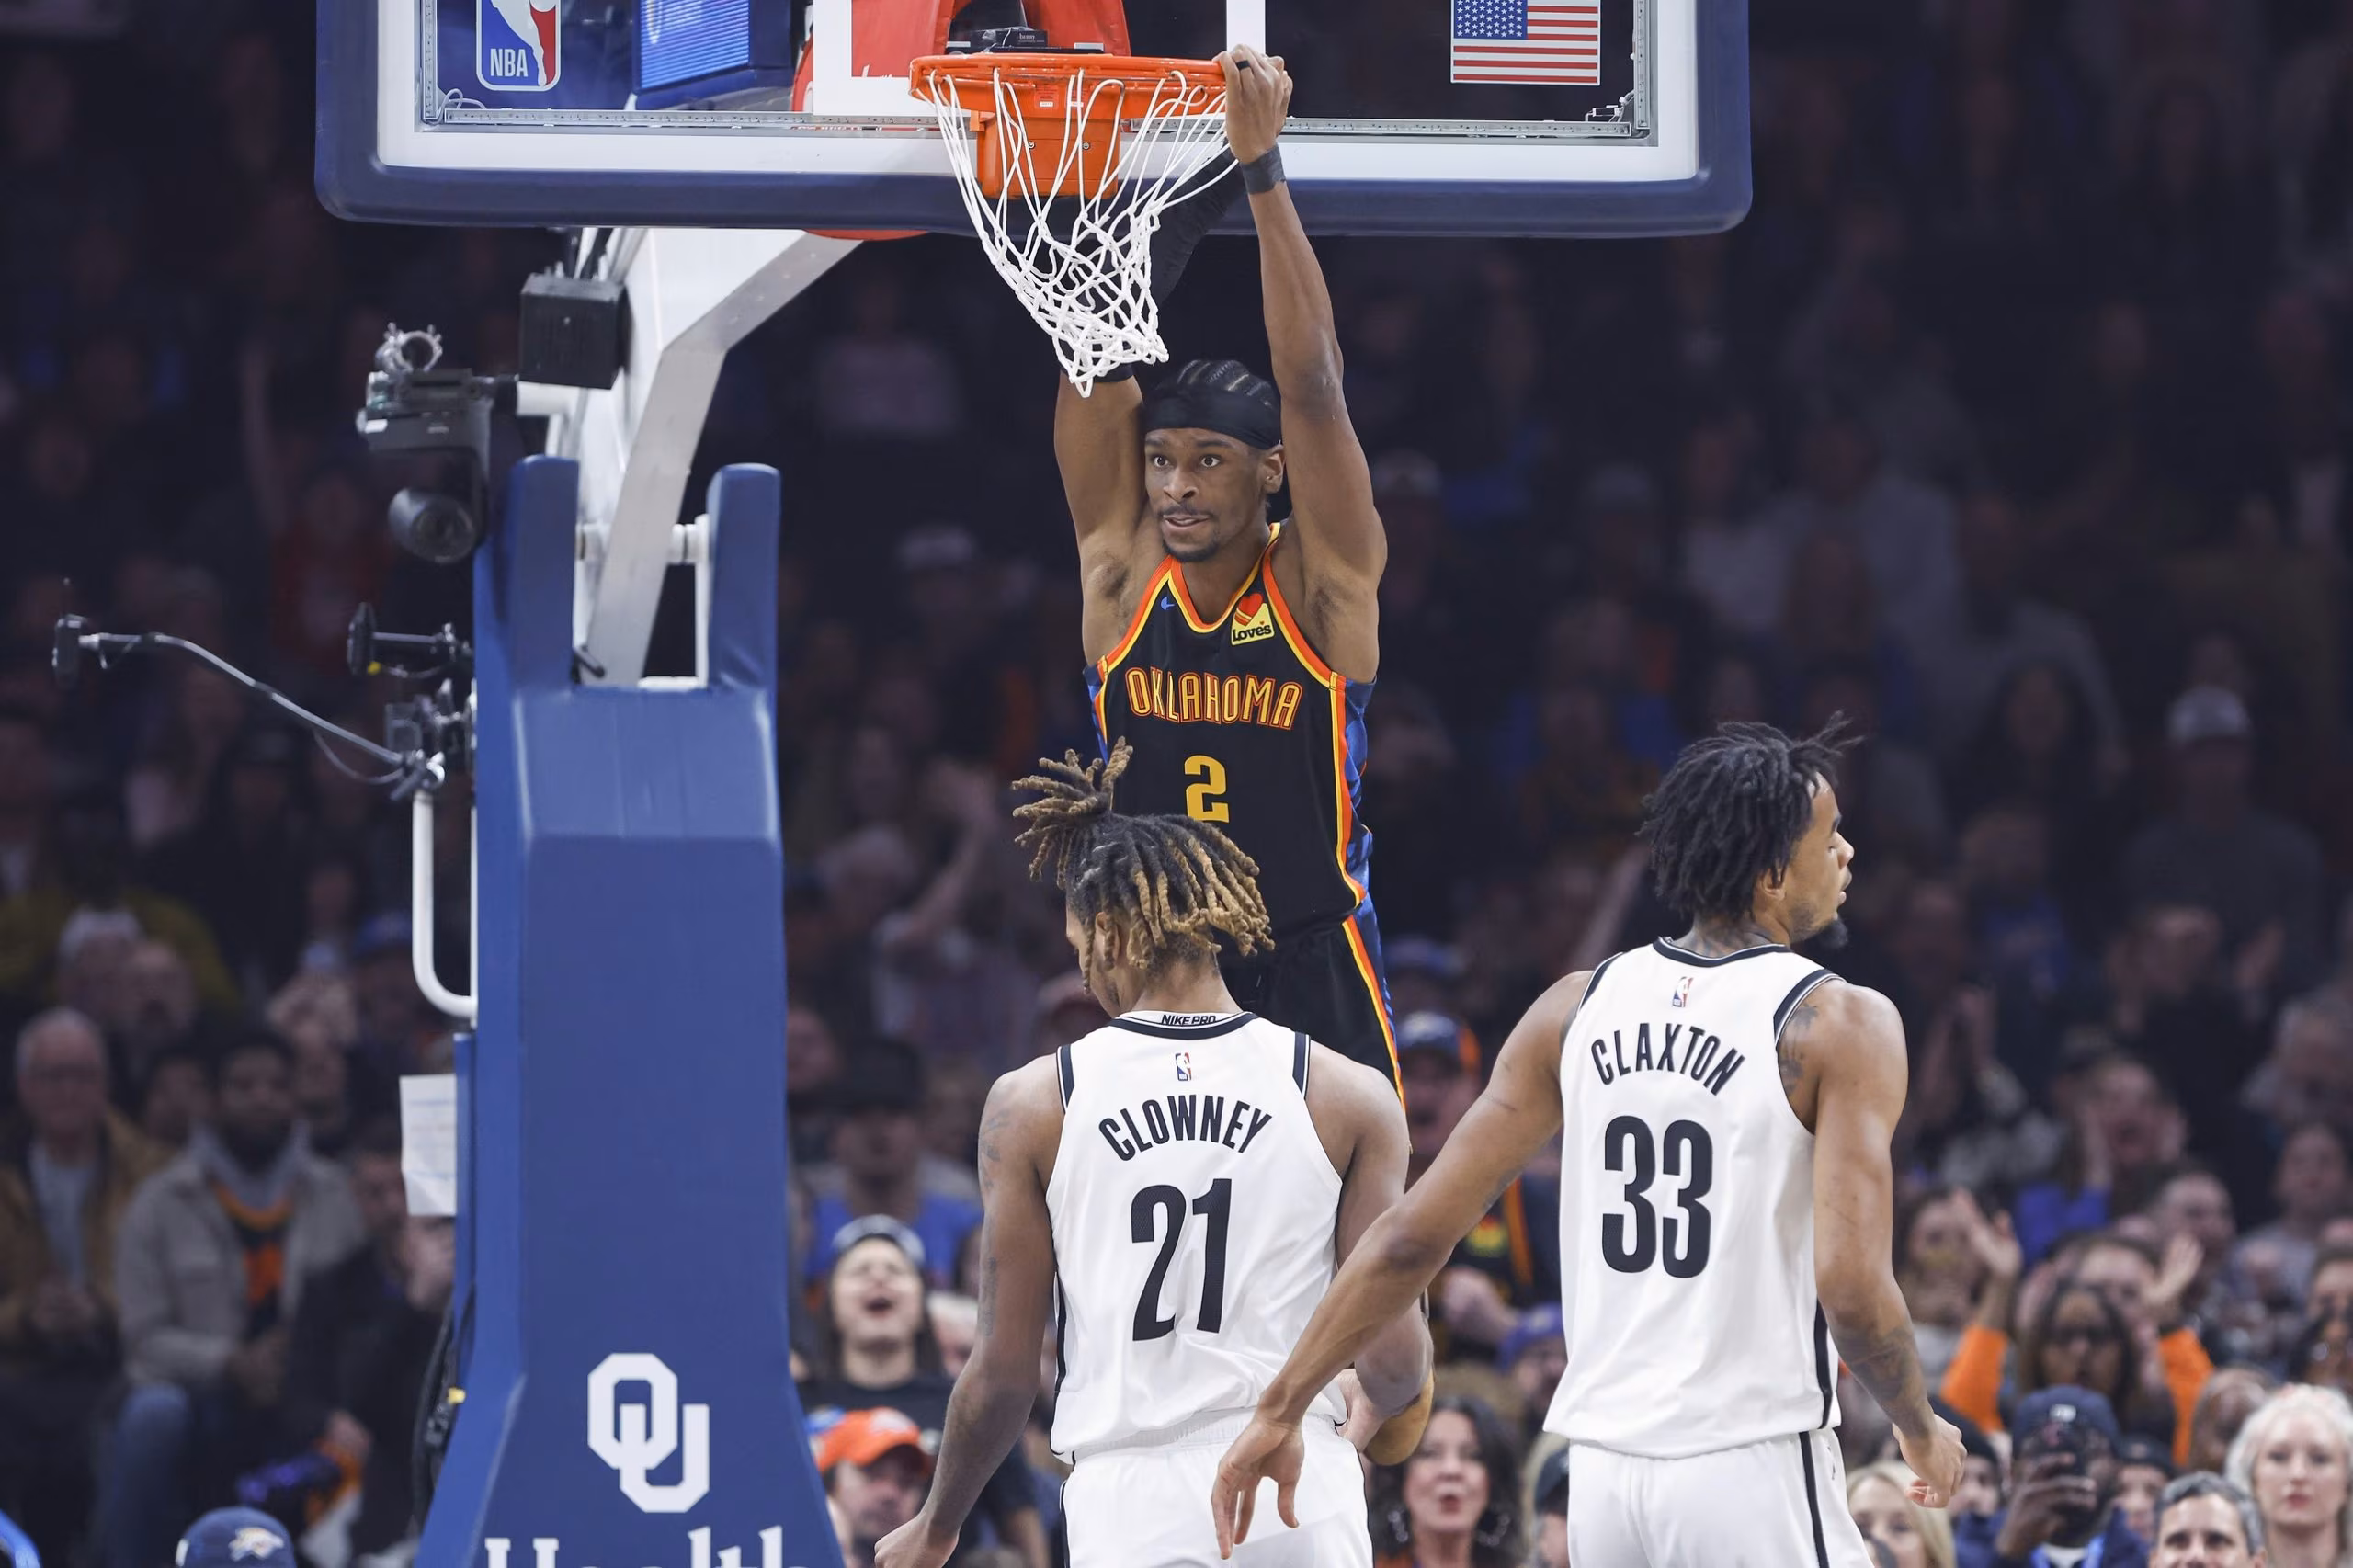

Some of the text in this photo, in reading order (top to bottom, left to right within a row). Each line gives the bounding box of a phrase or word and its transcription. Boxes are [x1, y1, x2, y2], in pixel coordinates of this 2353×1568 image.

[490, 48, 529, 77] NBA
[1125, 666, 1302, 730] OKLAHOMA
[1184, 755, 1230, 823] 2
[1161, 1014, 1217, 1027] NIKE PRO
[1590, 1022, 1746, 1096] CLAXTON
[1098, 1094, 1273, 1161] CLOWNEY
[1602, 1115, 1713, 1278] 33
[1130, 1178, 1233, 1341] 21
[587, 1352, 710, 1513] OU
